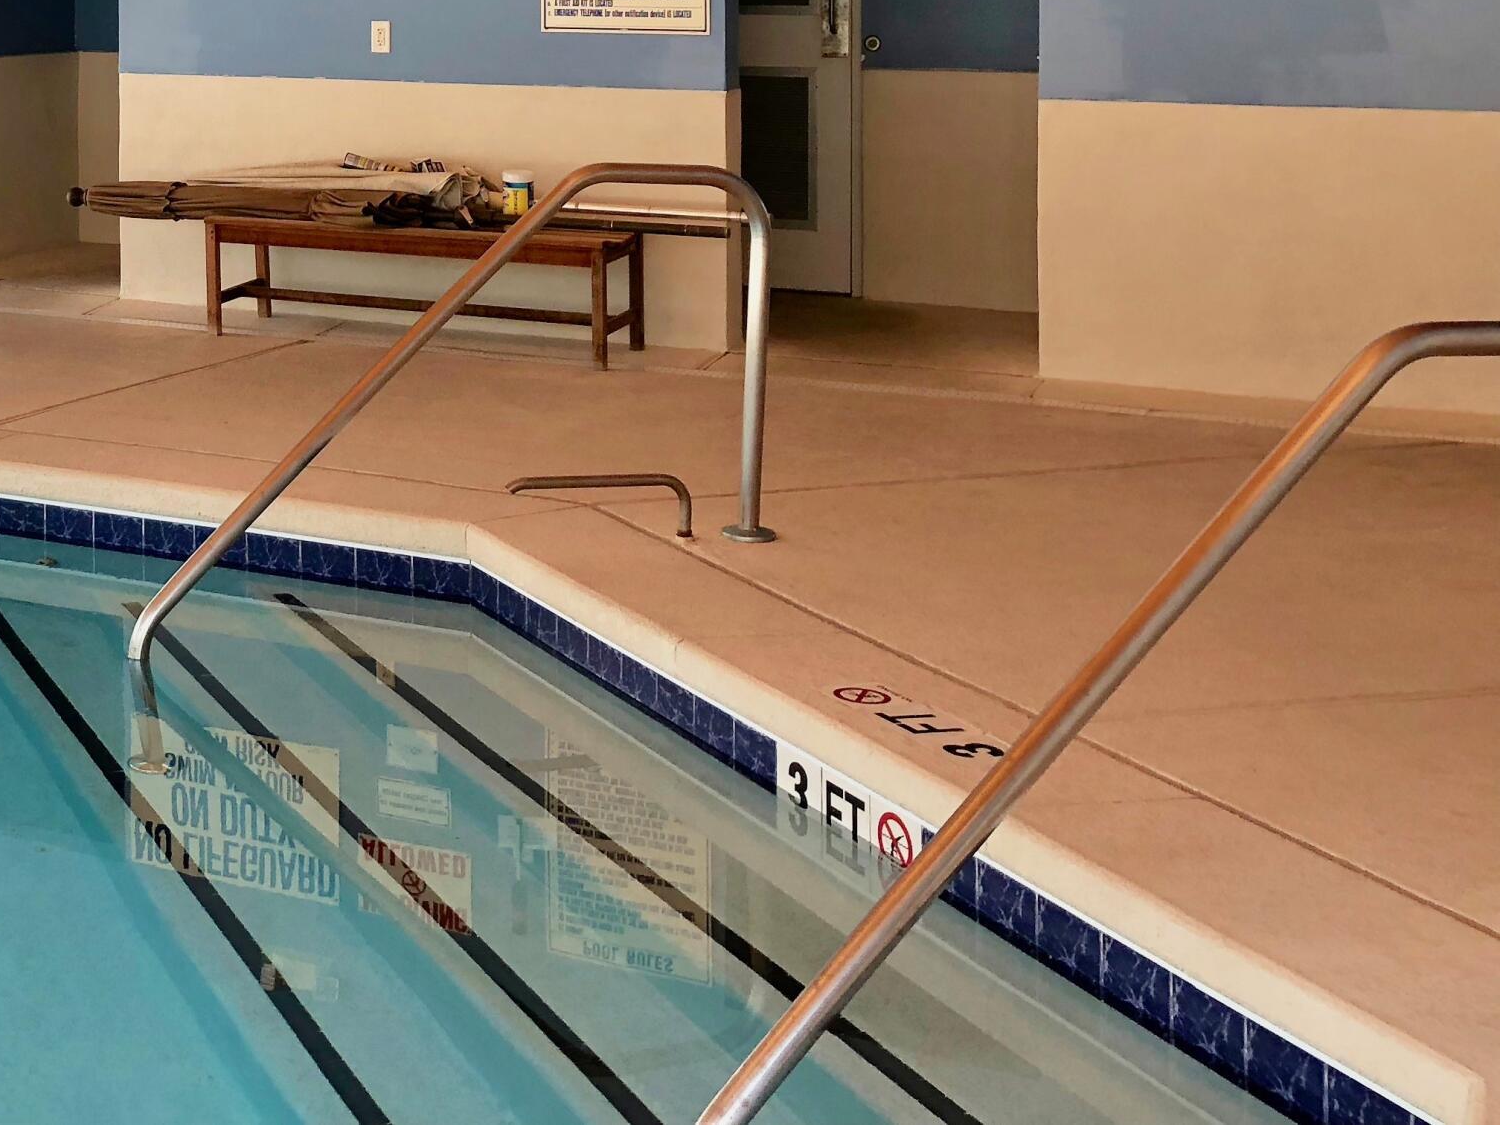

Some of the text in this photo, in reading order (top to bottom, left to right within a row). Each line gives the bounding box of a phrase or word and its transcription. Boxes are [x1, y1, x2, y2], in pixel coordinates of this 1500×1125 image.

[874, 712, 1004, 758] 3 FT
[788, 762, 865, 843] 3 FT
